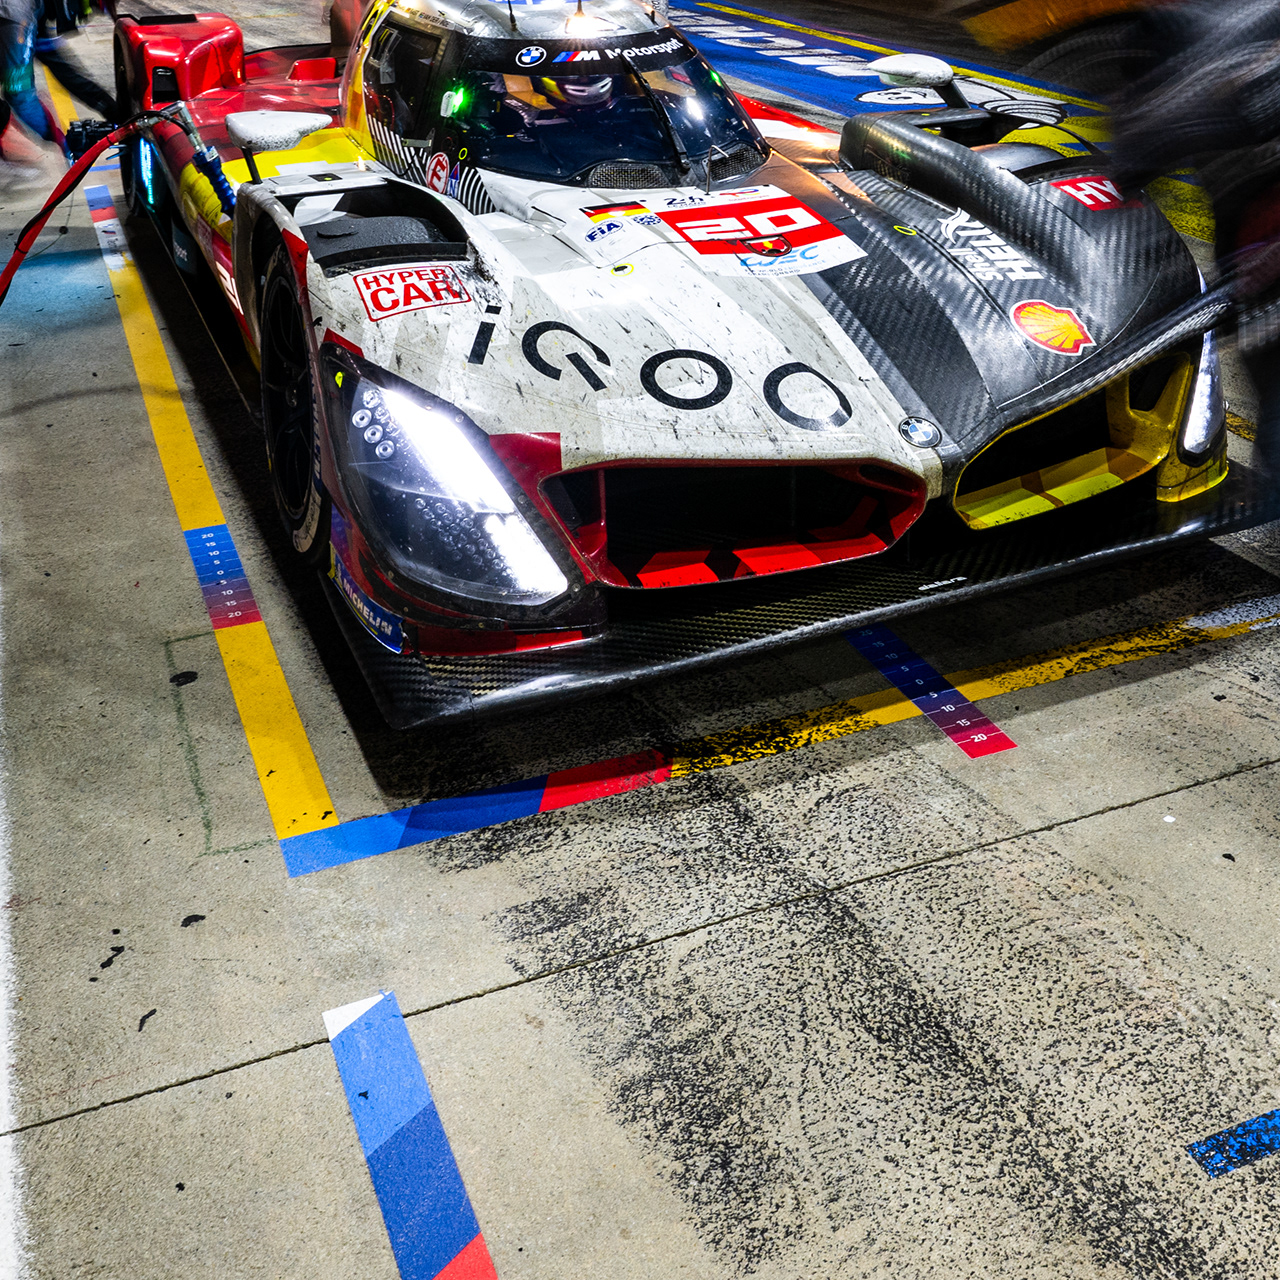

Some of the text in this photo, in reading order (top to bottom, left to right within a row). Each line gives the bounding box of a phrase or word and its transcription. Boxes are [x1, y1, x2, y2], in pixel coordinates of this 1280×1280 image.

[603, 37, 685, 62] Motorsport
[674, 207, 822, 242] 20
[937, 207, 1045, 282] HELIX
[740, 244, 820, 267] WEC
[947, 247, 1005, 282] Shell
[361, 268, 450, 291] HYPER
[370, 280, 461, 313] CAR
[467, 305, 853, 431] iQOO
[201, 532, 214, 540] 20
[343, 578, 393, 636] MICHELIN
[227, 610, 242, 619] 20
[872, 640, 885, 648] 15
[885, 652, 899, 660] 10
[900, 665, 910, 673] 5
[915, 678, 925, 686] 0
[929, 691, 939, 699] 5
[941, 704, 956, 713] 10
[955, 719, 971, 728] 15
[970, 733, 988, 743] 20
